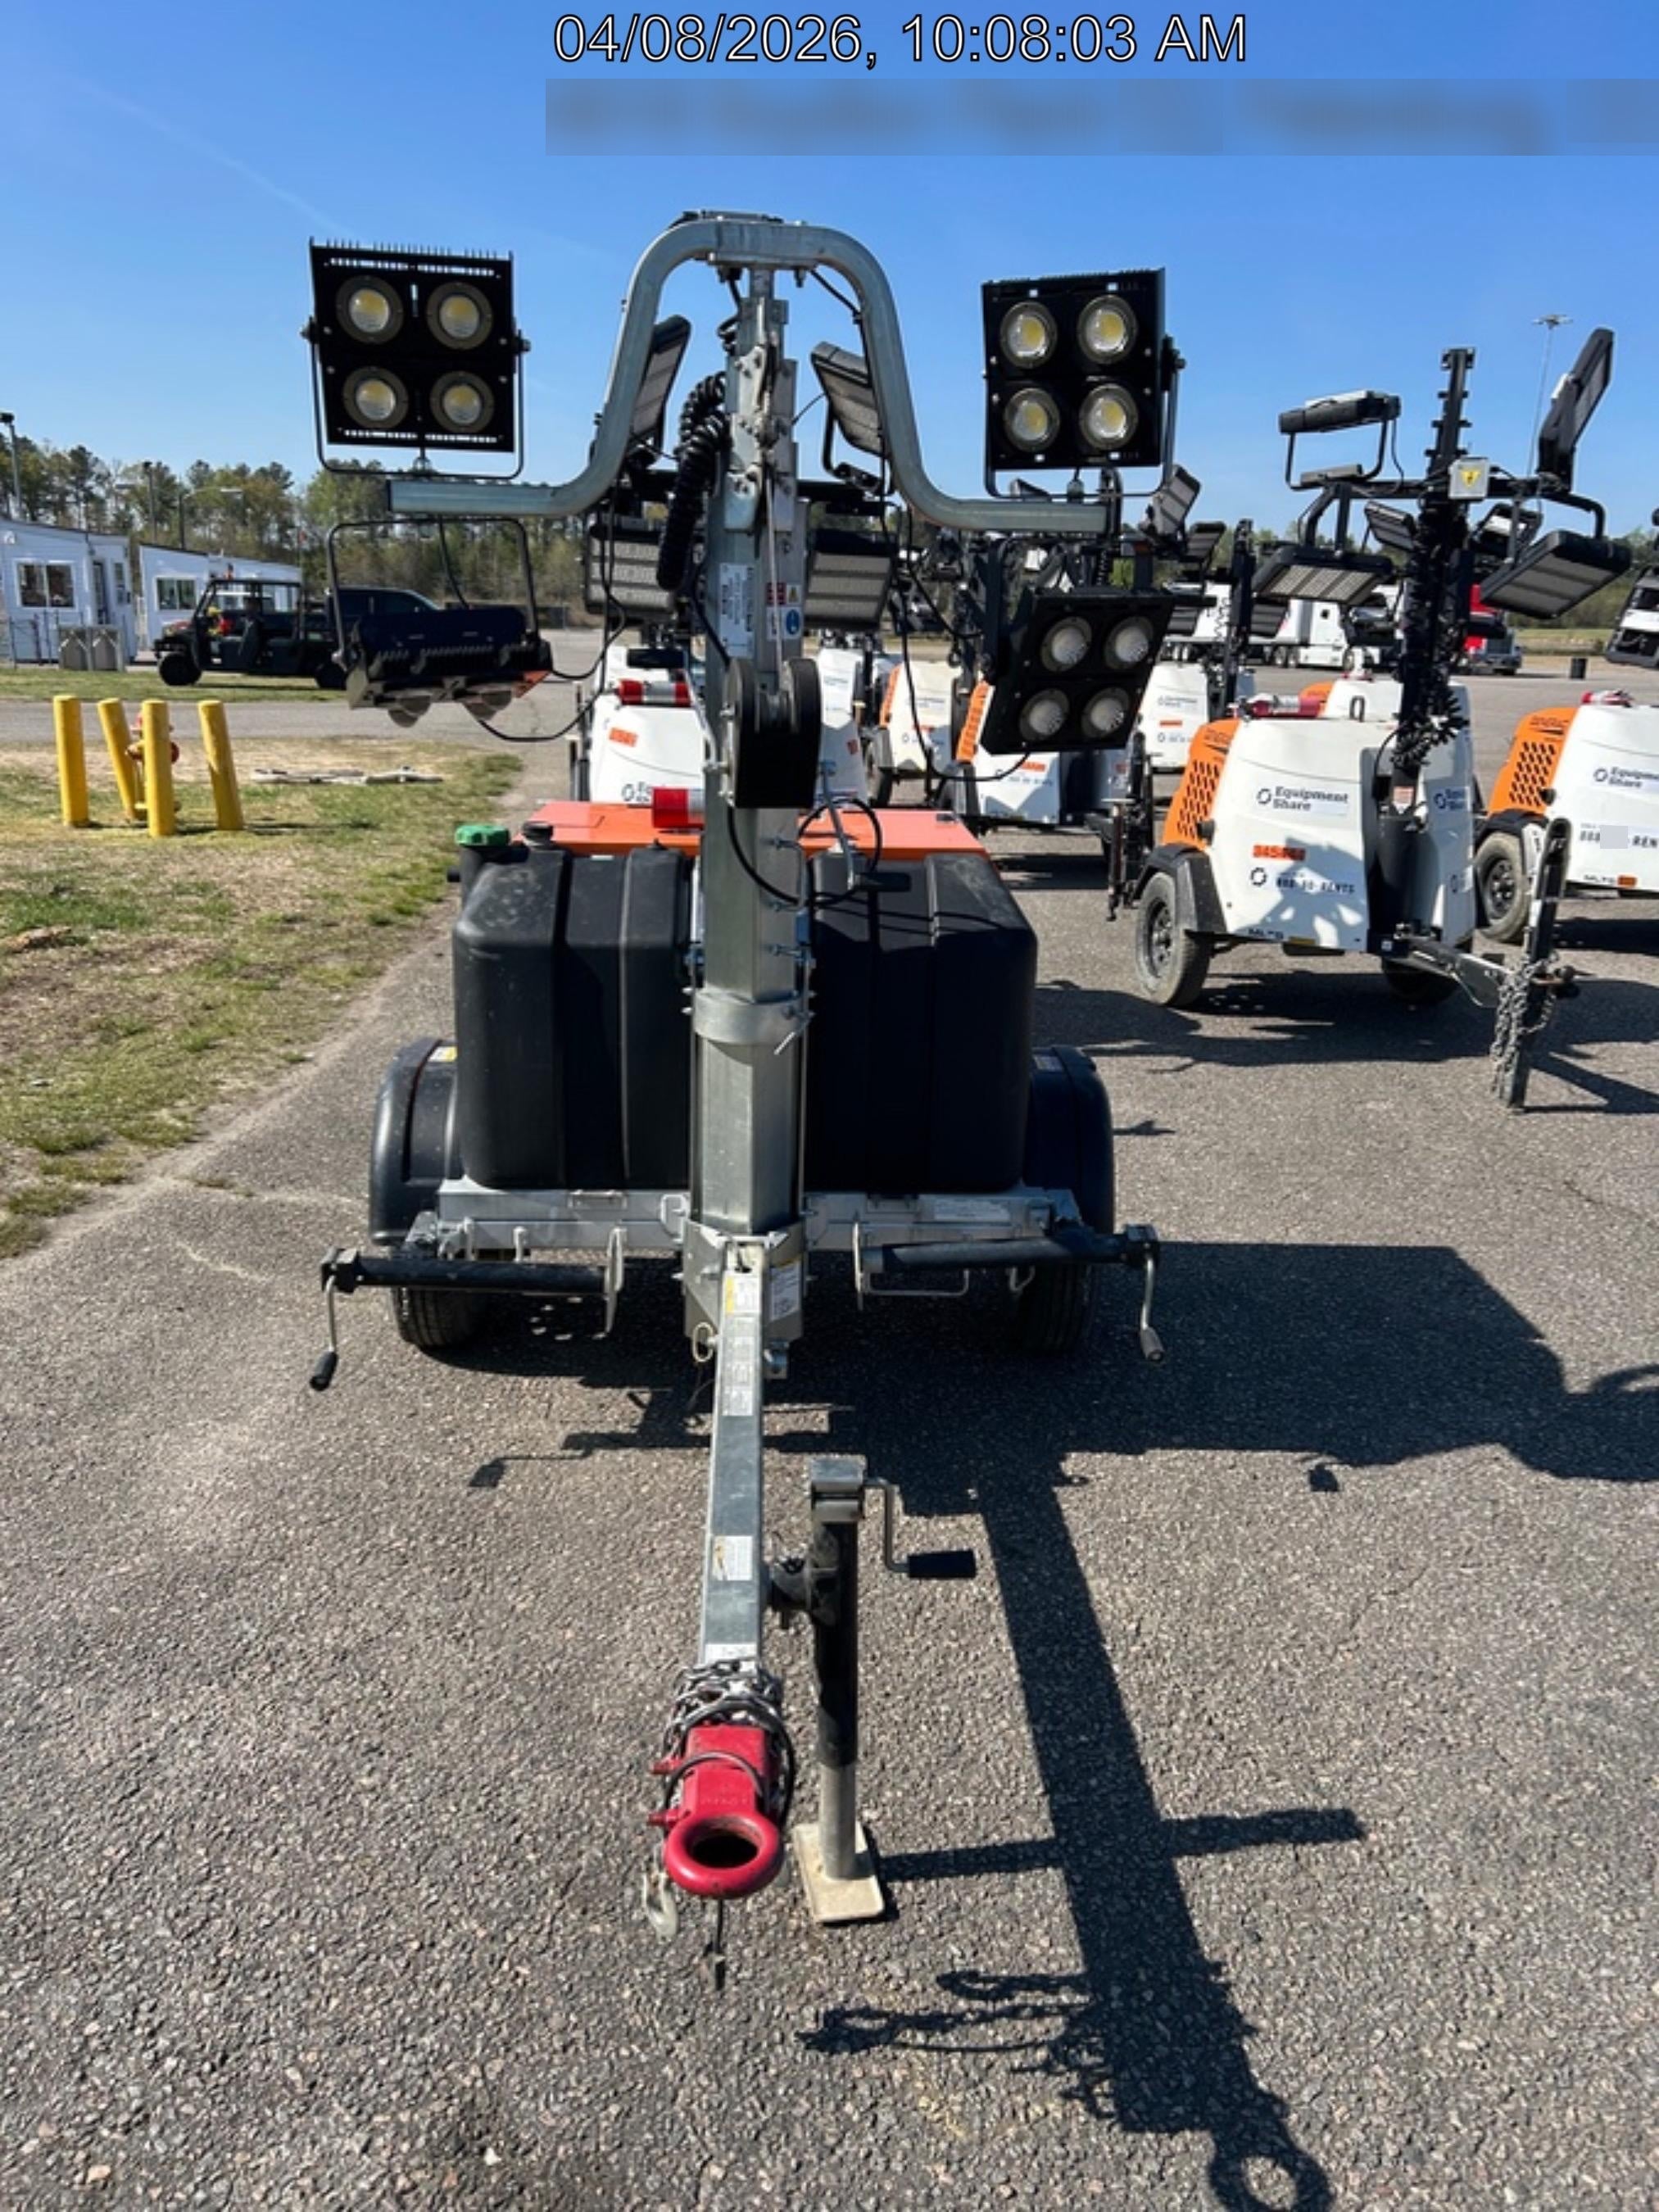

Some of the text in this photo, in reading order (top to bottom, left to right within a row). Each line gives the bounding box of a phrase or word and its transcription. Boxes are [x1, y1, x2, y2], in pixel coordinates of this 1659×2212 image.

[1609, 777, 1643, 788] Share
[1275, 786, 1349, 804] Equipment
[1273, 798, 1311, 810] Share
